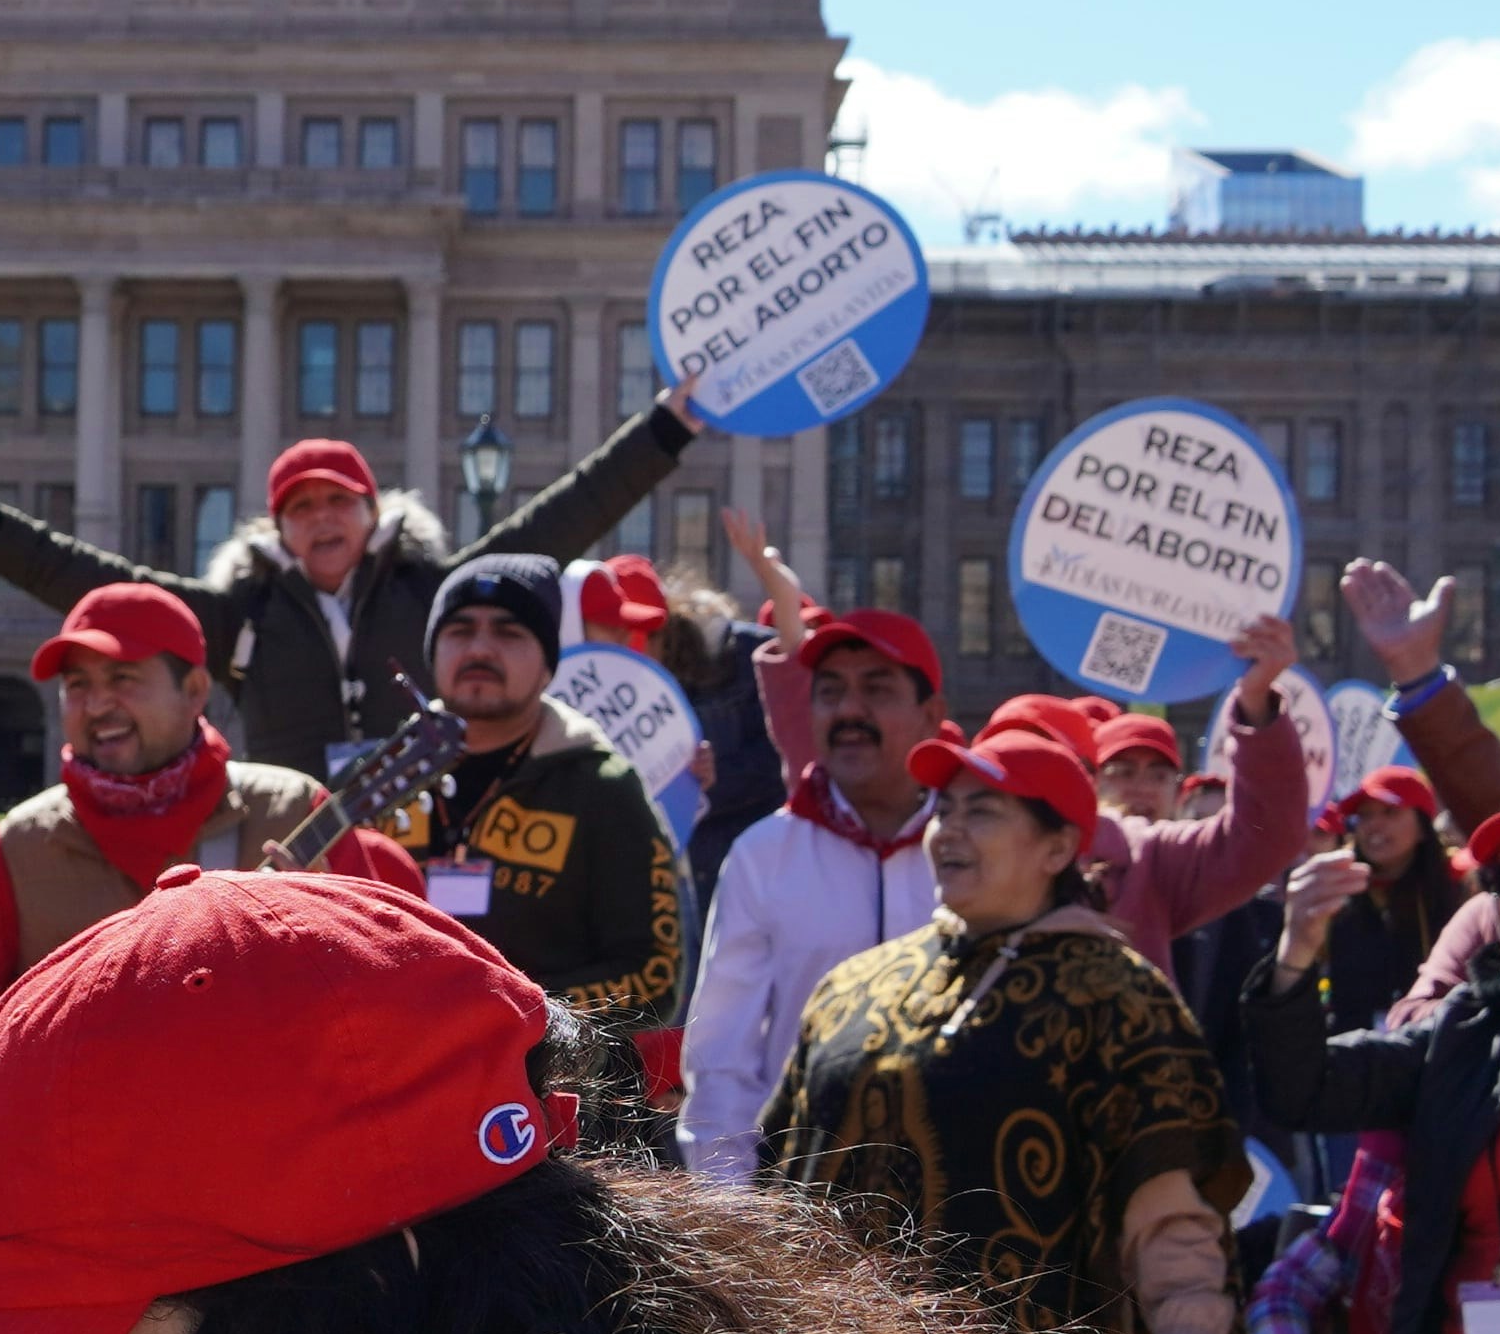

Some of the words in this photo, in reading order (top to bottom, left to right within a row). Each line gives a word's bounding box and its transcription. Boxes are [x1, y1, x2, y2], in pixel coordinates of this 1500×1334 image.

[671, 275, 744, 335] POR
[748, 247, 795, 283] EL
[795, 197, 852, 248] FIN
[692, 199, 786, 270] REZA
[679, 328, 750, 377] DEL
[756, 222, 888, 332] ABORTO
[1144, 425, 1240, 483] REZA
[1076, 454, 1158, 503] POR
[1168, 484, 1209, 522] EL
[1222, 501, 1279, 543] FIN
[1041, 494, 1112, 540] DEL
[1125, 523, 1282, 592] ABORTO
[552, 658, 602, 709] RAY
[584, 681, 638, 729] ND
[613, 692, 676, 758] TION
